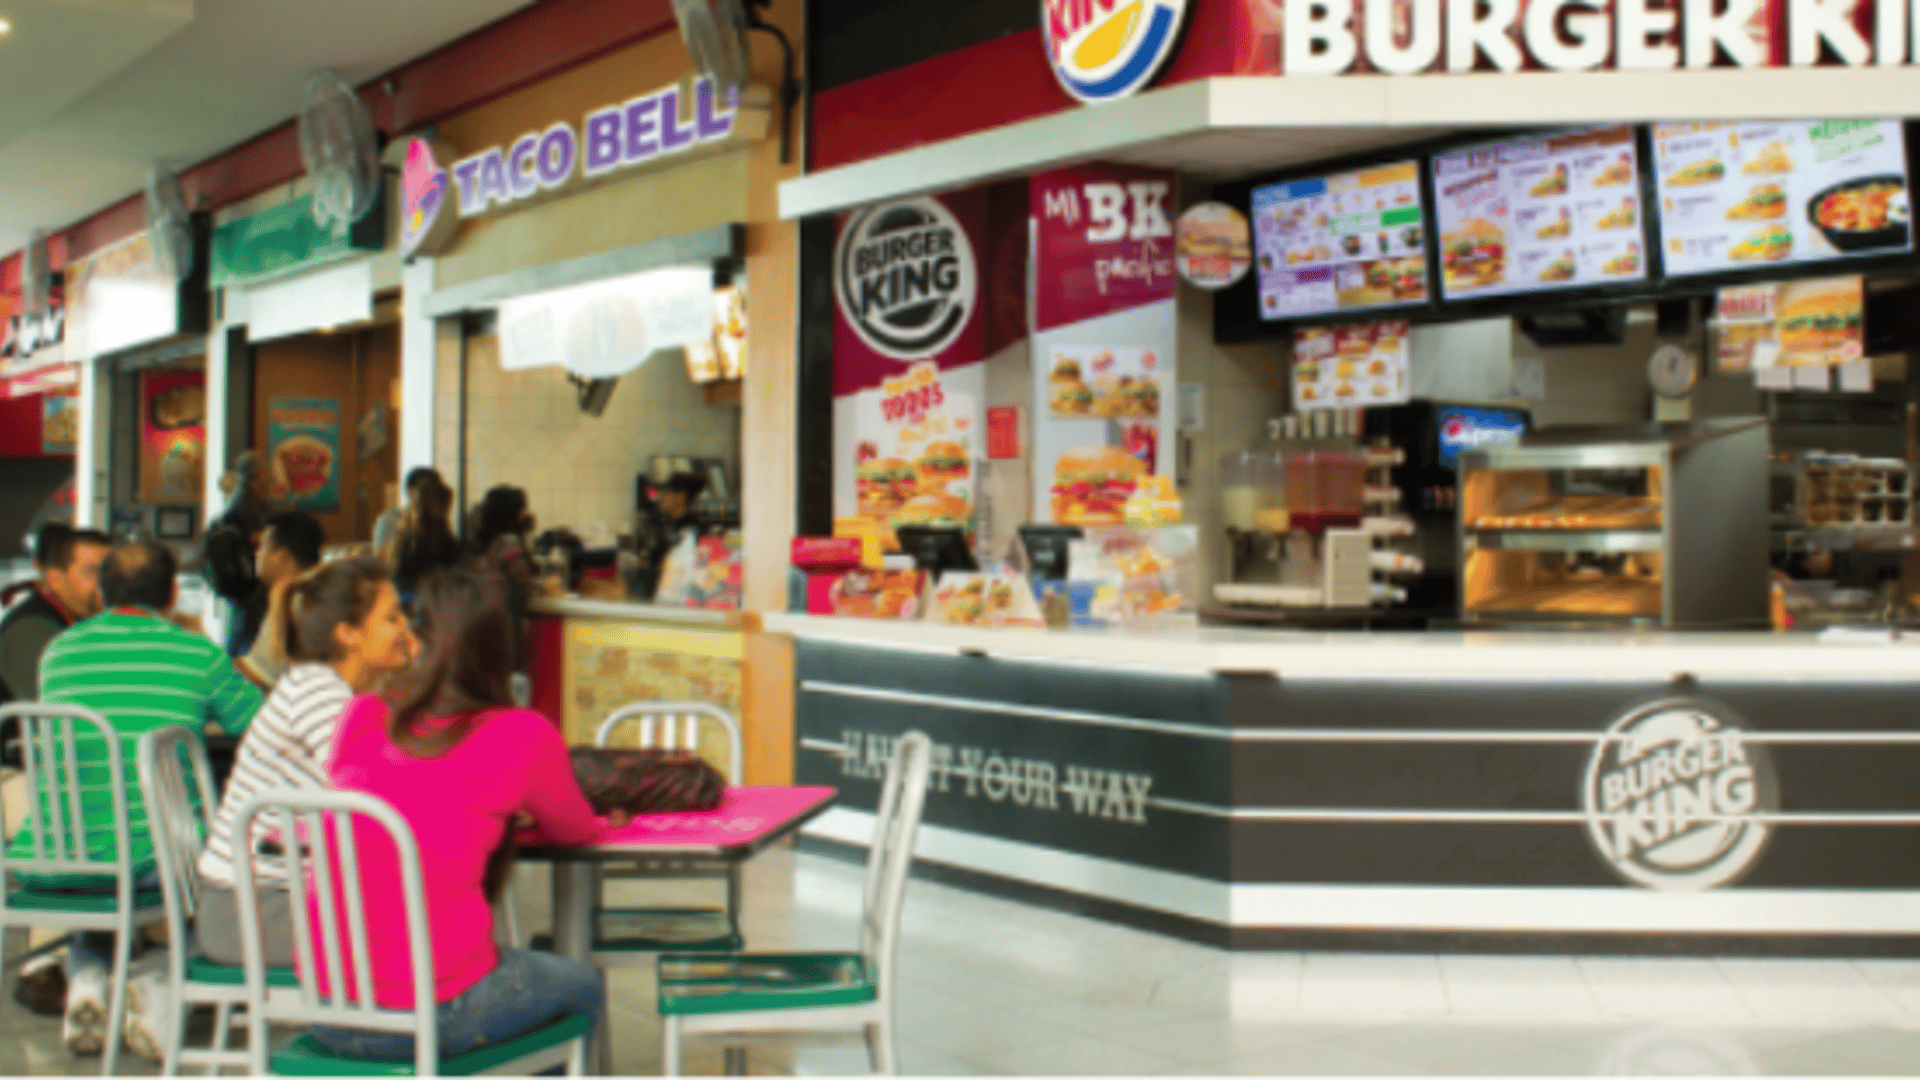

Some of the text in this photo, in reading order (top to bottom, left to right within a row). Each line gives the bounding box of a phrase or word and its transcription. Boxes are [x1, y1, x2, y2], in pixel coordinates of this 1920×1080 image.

[1284, 0, 1760, 74] BURGER
[452, 74, 732, 217] TACO BELL
[1084, 181, 1171, 242] BK
[855, 226, 955, 277] BURGER
[861, 255, 960, 316] KING
[960, 746, 1059, 810] YOUR
[1064, 763, 1153, 824] WAY
[1602, 728, 1746, 812] BURGER
[1612, 766, 1757, 859] KING
